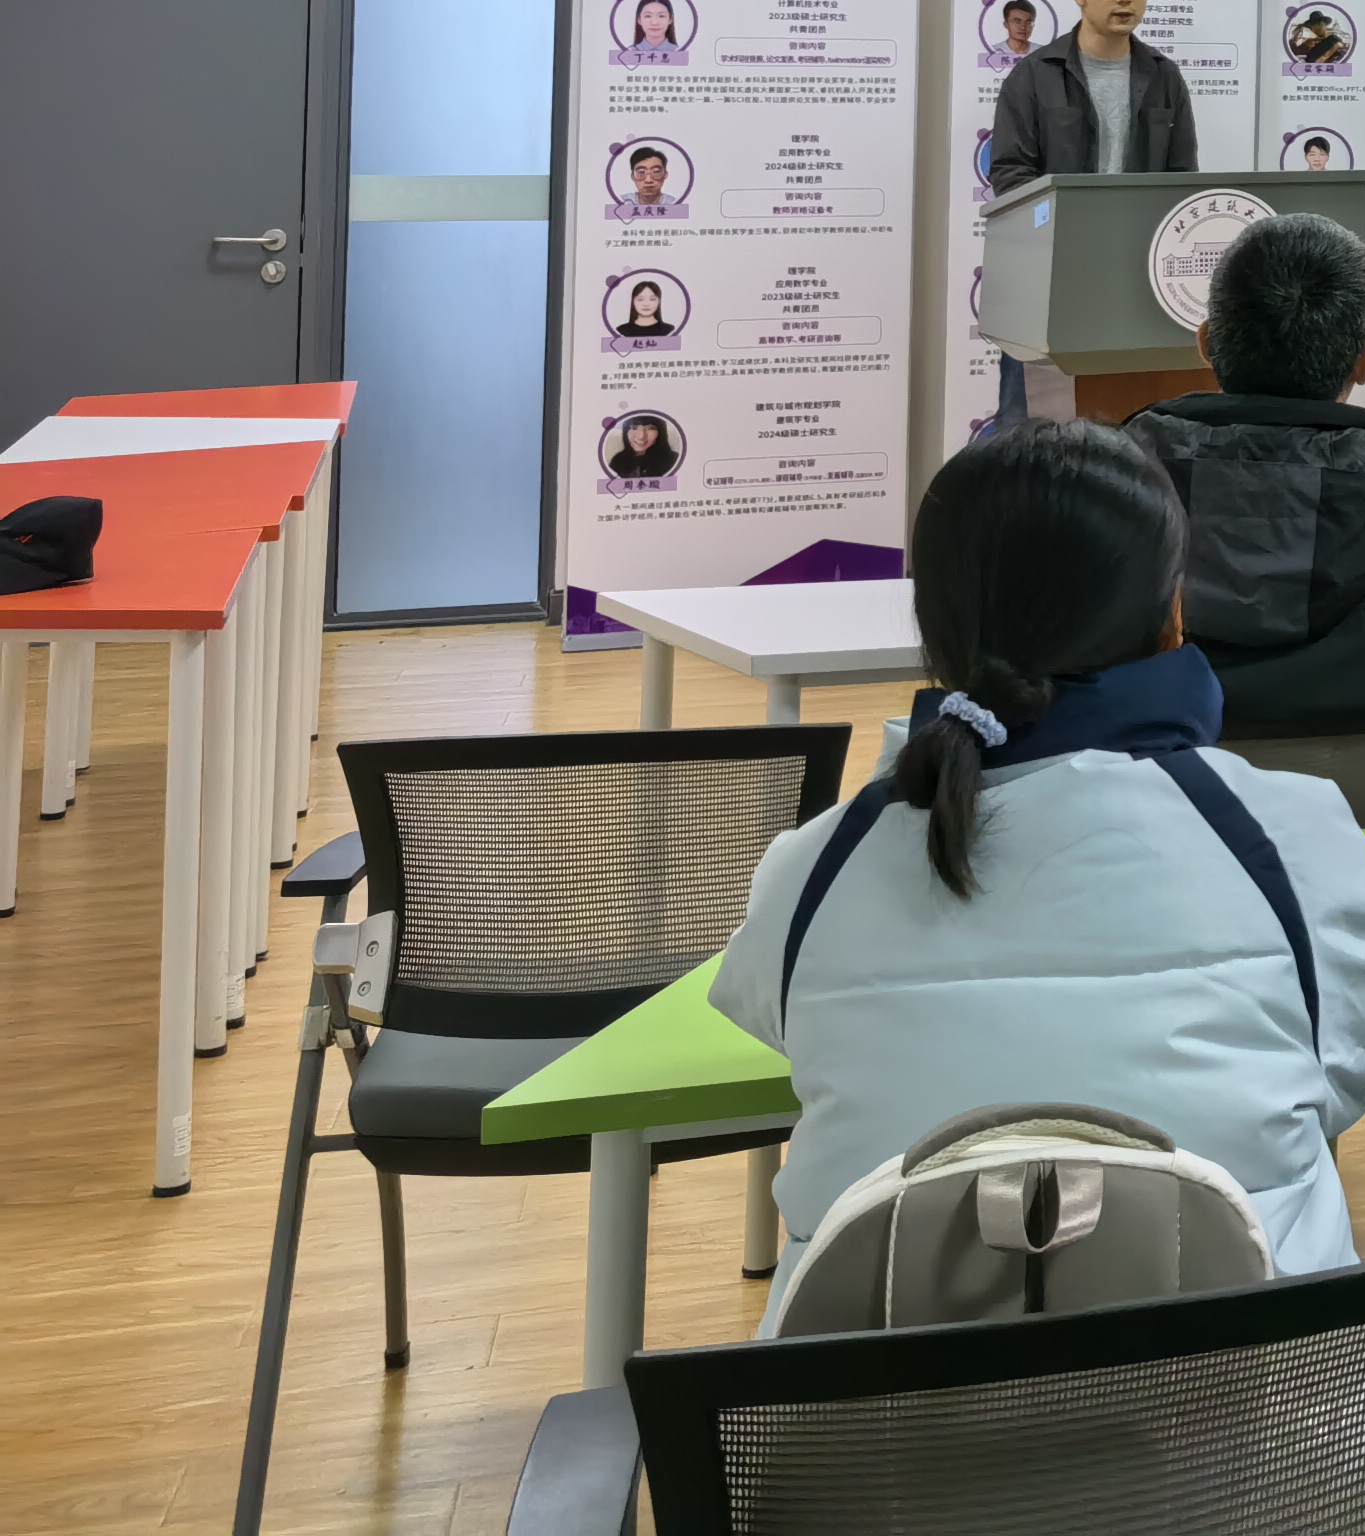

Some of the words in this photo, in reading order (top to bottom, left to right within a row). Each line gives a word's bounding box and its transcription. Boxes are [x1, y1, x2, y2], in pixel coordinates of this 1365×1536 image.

[1142, 17, 1194, 26] 级硕士研究生
